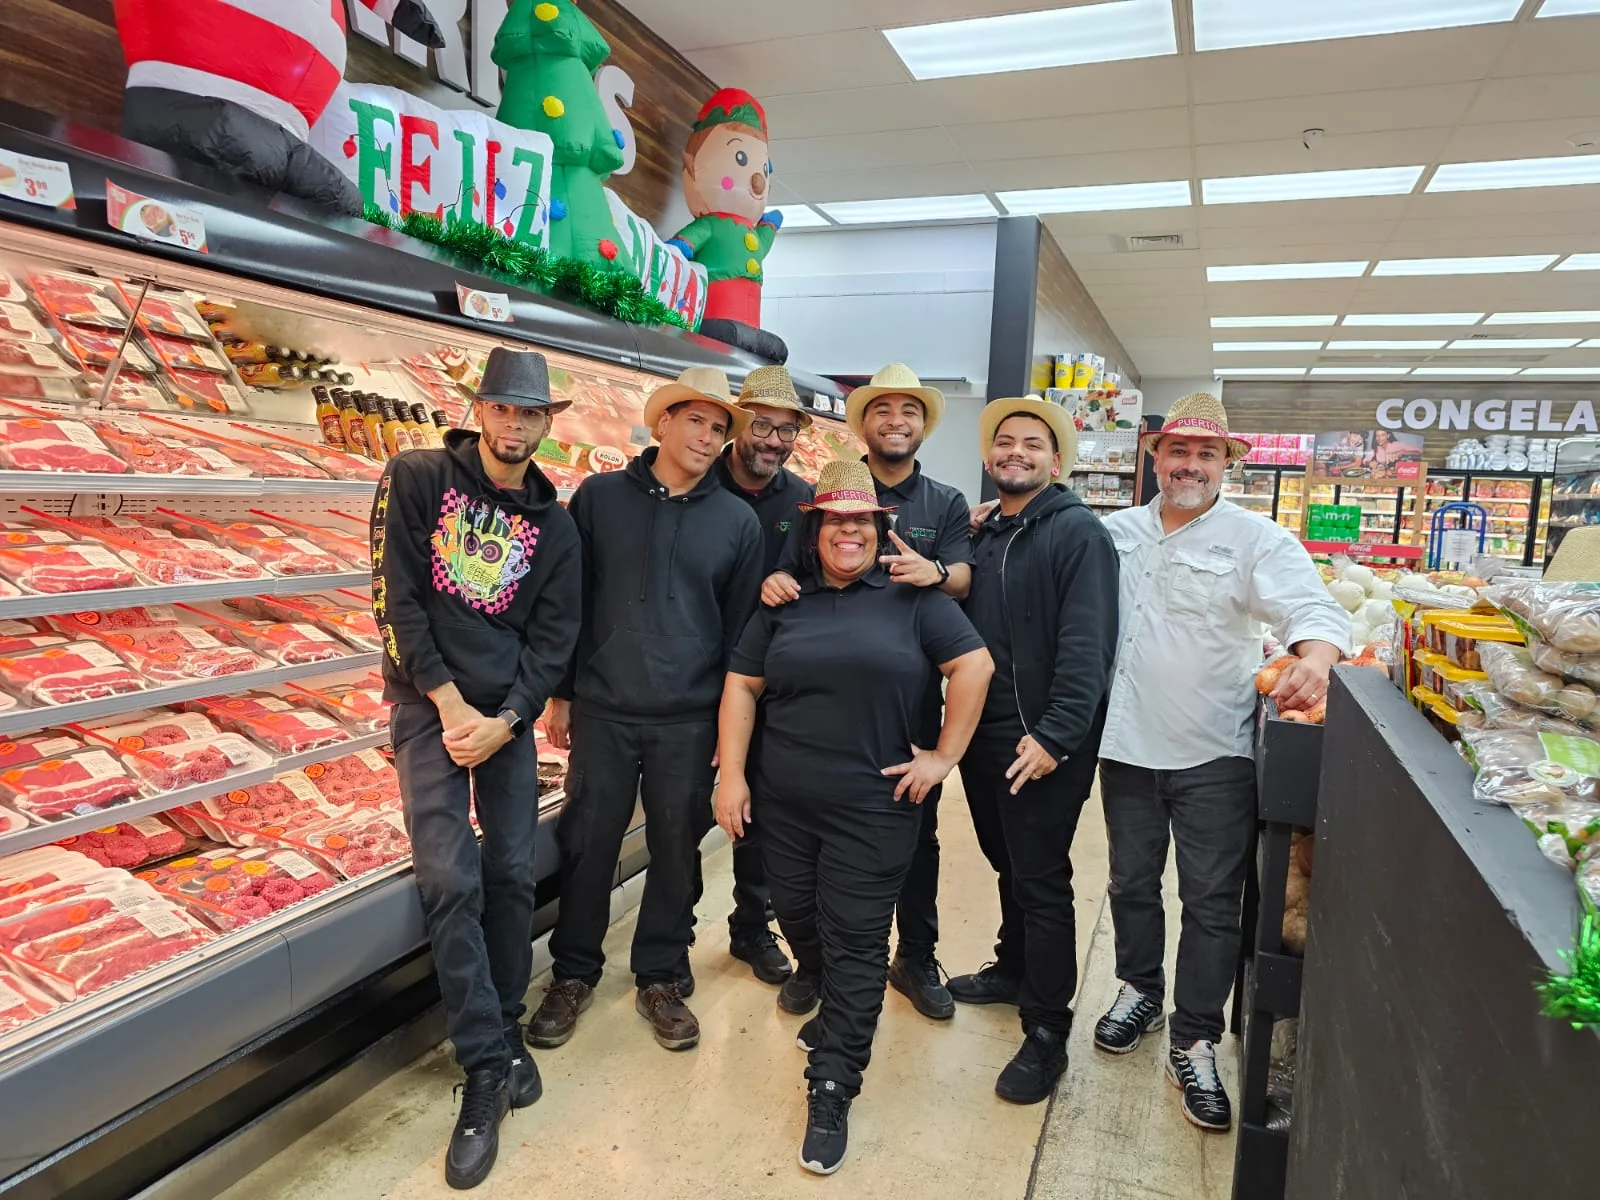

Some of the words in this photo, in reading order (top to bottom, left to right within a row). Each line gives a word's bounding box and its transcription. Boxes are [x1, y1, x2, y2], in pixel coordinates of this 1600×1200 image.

[1376, 398, 1599, 431] CONGELA
[1178, 418, 1217, 432] PUERTO
[832, 490, 867, 501] PUERTO
